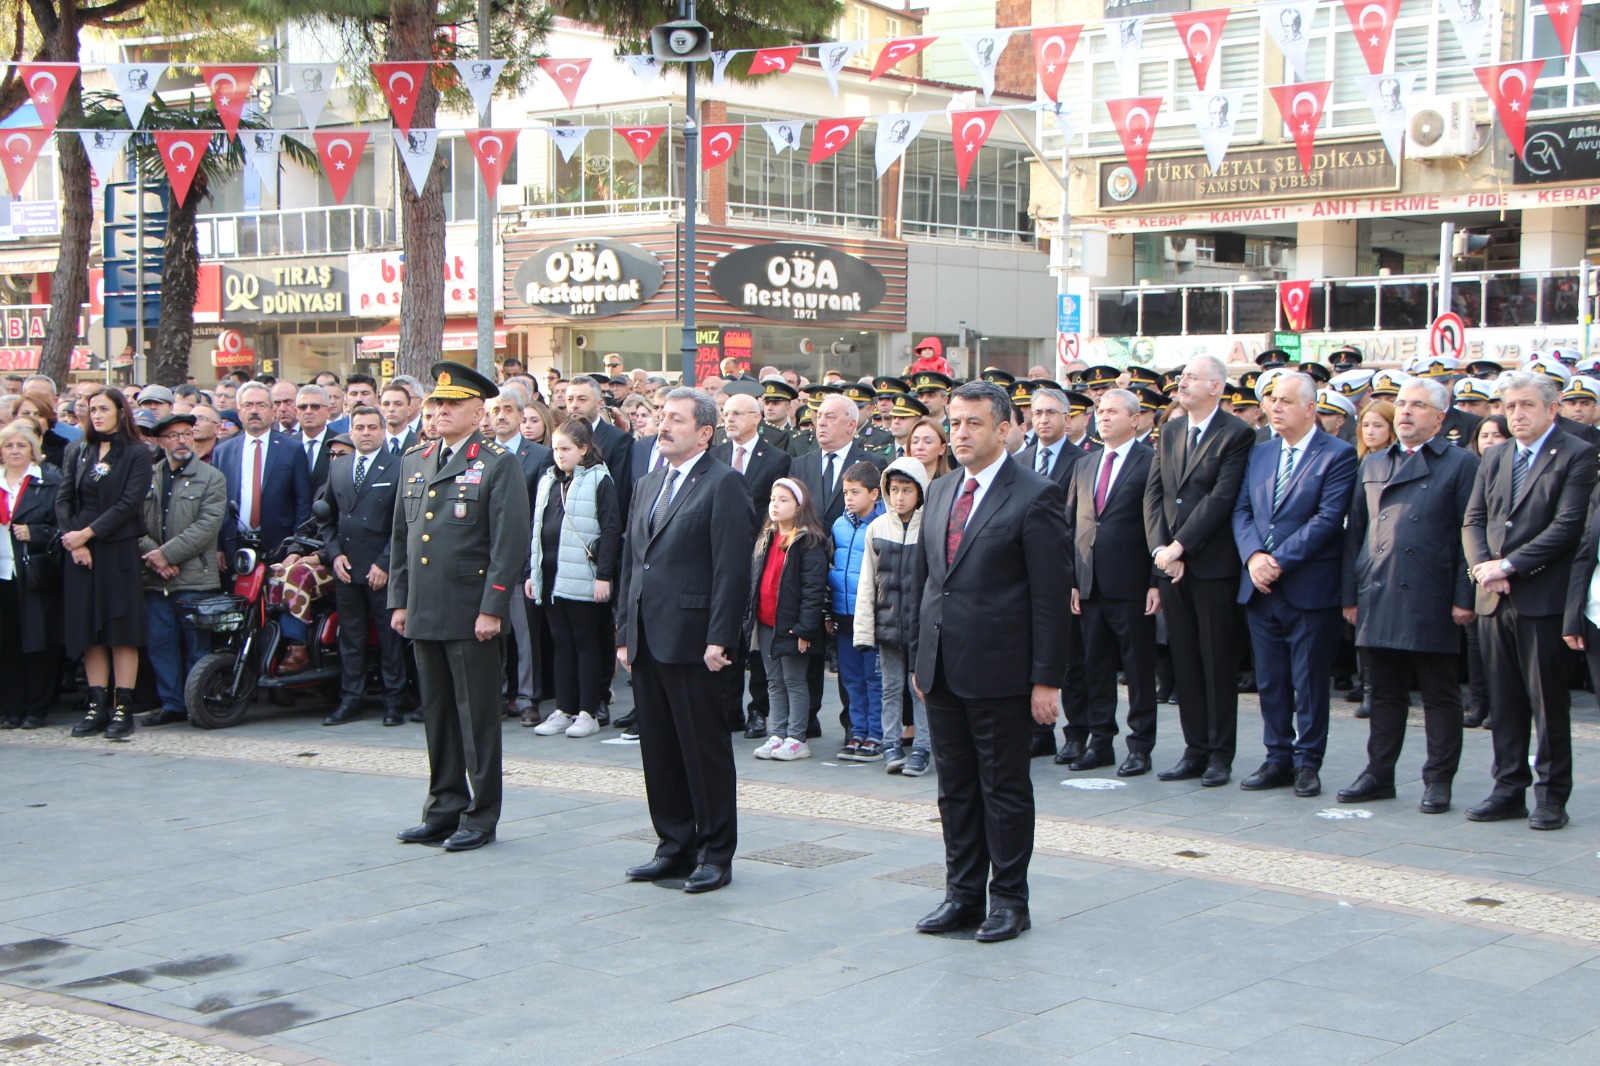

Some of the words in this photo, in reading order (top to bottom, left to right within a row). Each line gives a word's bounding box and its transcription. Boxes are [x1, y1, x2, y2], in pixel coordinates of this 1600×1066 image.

[1145, 163, 1196, 183] TÜRK
[1203, 158, 1267, 179] METAL
[1275, 147, 1386, 174] SEDİKASI
[1199, 177, 1261, 195] SAMSUN
[1269, 170, 1325, 192] ŞUBESİ
[1138, 214, 1188, 229] KEBAP
[1209, 207, 1287, 224] KAHVALTI
[1311, 199, 1359, 217] ANIT
[1369, 194, 1439, 213] TERME
[1537, 187, 1600, 203] KEBAP
[272, 265, 333, 289] TIRAŞ
[545, 249, 622, 283] OBA
[766, 254, 838, 290] OBA
[262, 291, 343, 314] DÜNYASI
[525, 278, 641, 305] Restaurant
[743, 283, 861, 312] Restaurant
[570, 303, 596, 315] 1971
[793, 309, 817, 320] 1971
[217, 354, 253, 364] vodafone
